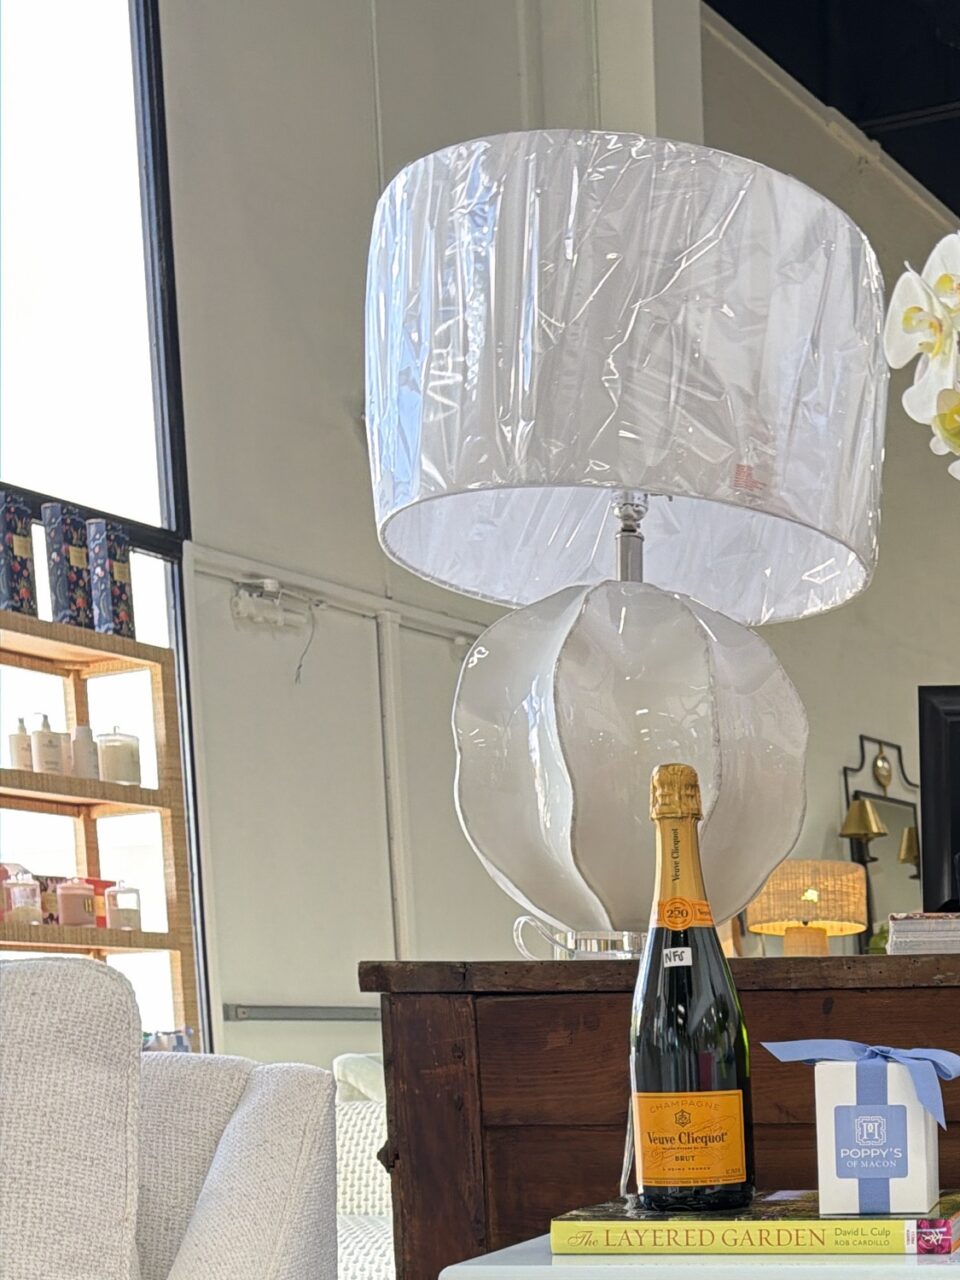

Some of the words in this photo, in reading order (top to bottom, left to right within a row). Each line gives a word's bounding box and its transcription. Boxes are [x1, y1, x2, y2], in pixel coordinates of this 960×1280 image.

[671, 828, 681, 859] Clicquot
[672, 861, 680, 882] Veuve
[666, 907, 689, 919] 250
[650, 1099, 721, 1113] CHAMPAGNE
[647, 1131, 676, 1145] Veuve
[678, 1131, 727, 1146] Clicquot
[840, 1148, 903, 1159] POPPY'S
[846, 1160, 859, 1168] OF
[861, 1160, 897, 1168] MACON
[567, 1229, 599, 1248] The
[604, 1228, 716, 1248] LAYERED
[721, 1228, 826, 1248] GARDEN
[834, 1227, 859, 1237] David
[860, 1227, 868, 1237] L.
[870, 1227, 891, 1239] Culp
